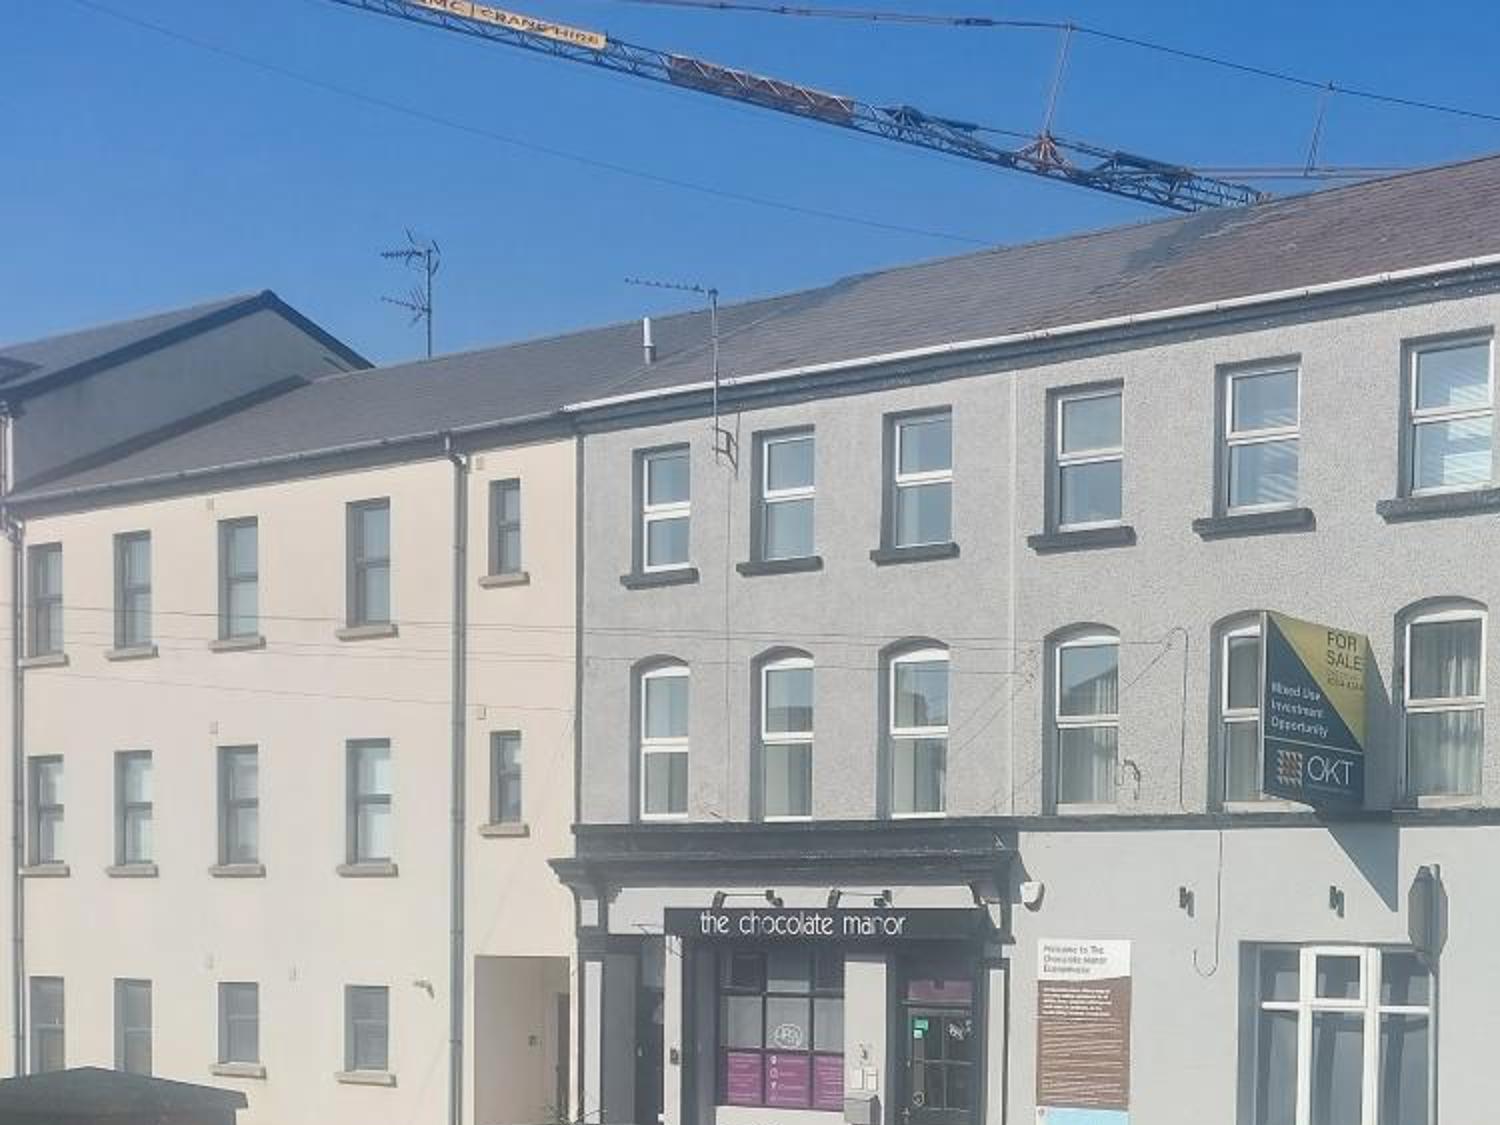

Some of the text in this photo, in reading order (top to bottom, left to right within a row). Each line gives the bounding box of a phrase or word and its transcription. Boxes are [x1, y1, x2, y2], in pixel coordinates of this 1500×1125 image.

[1327, 630, 1358, 653] FOR
[1327, 649, 1362, 672] SALE
[1271, 699, 1323, 718] Investment
[1271, 716, 1329, 738] Opportunity
[1307, 755, 1354, 785] OKT
[700, 910, 906, 936] the chocolate manor
